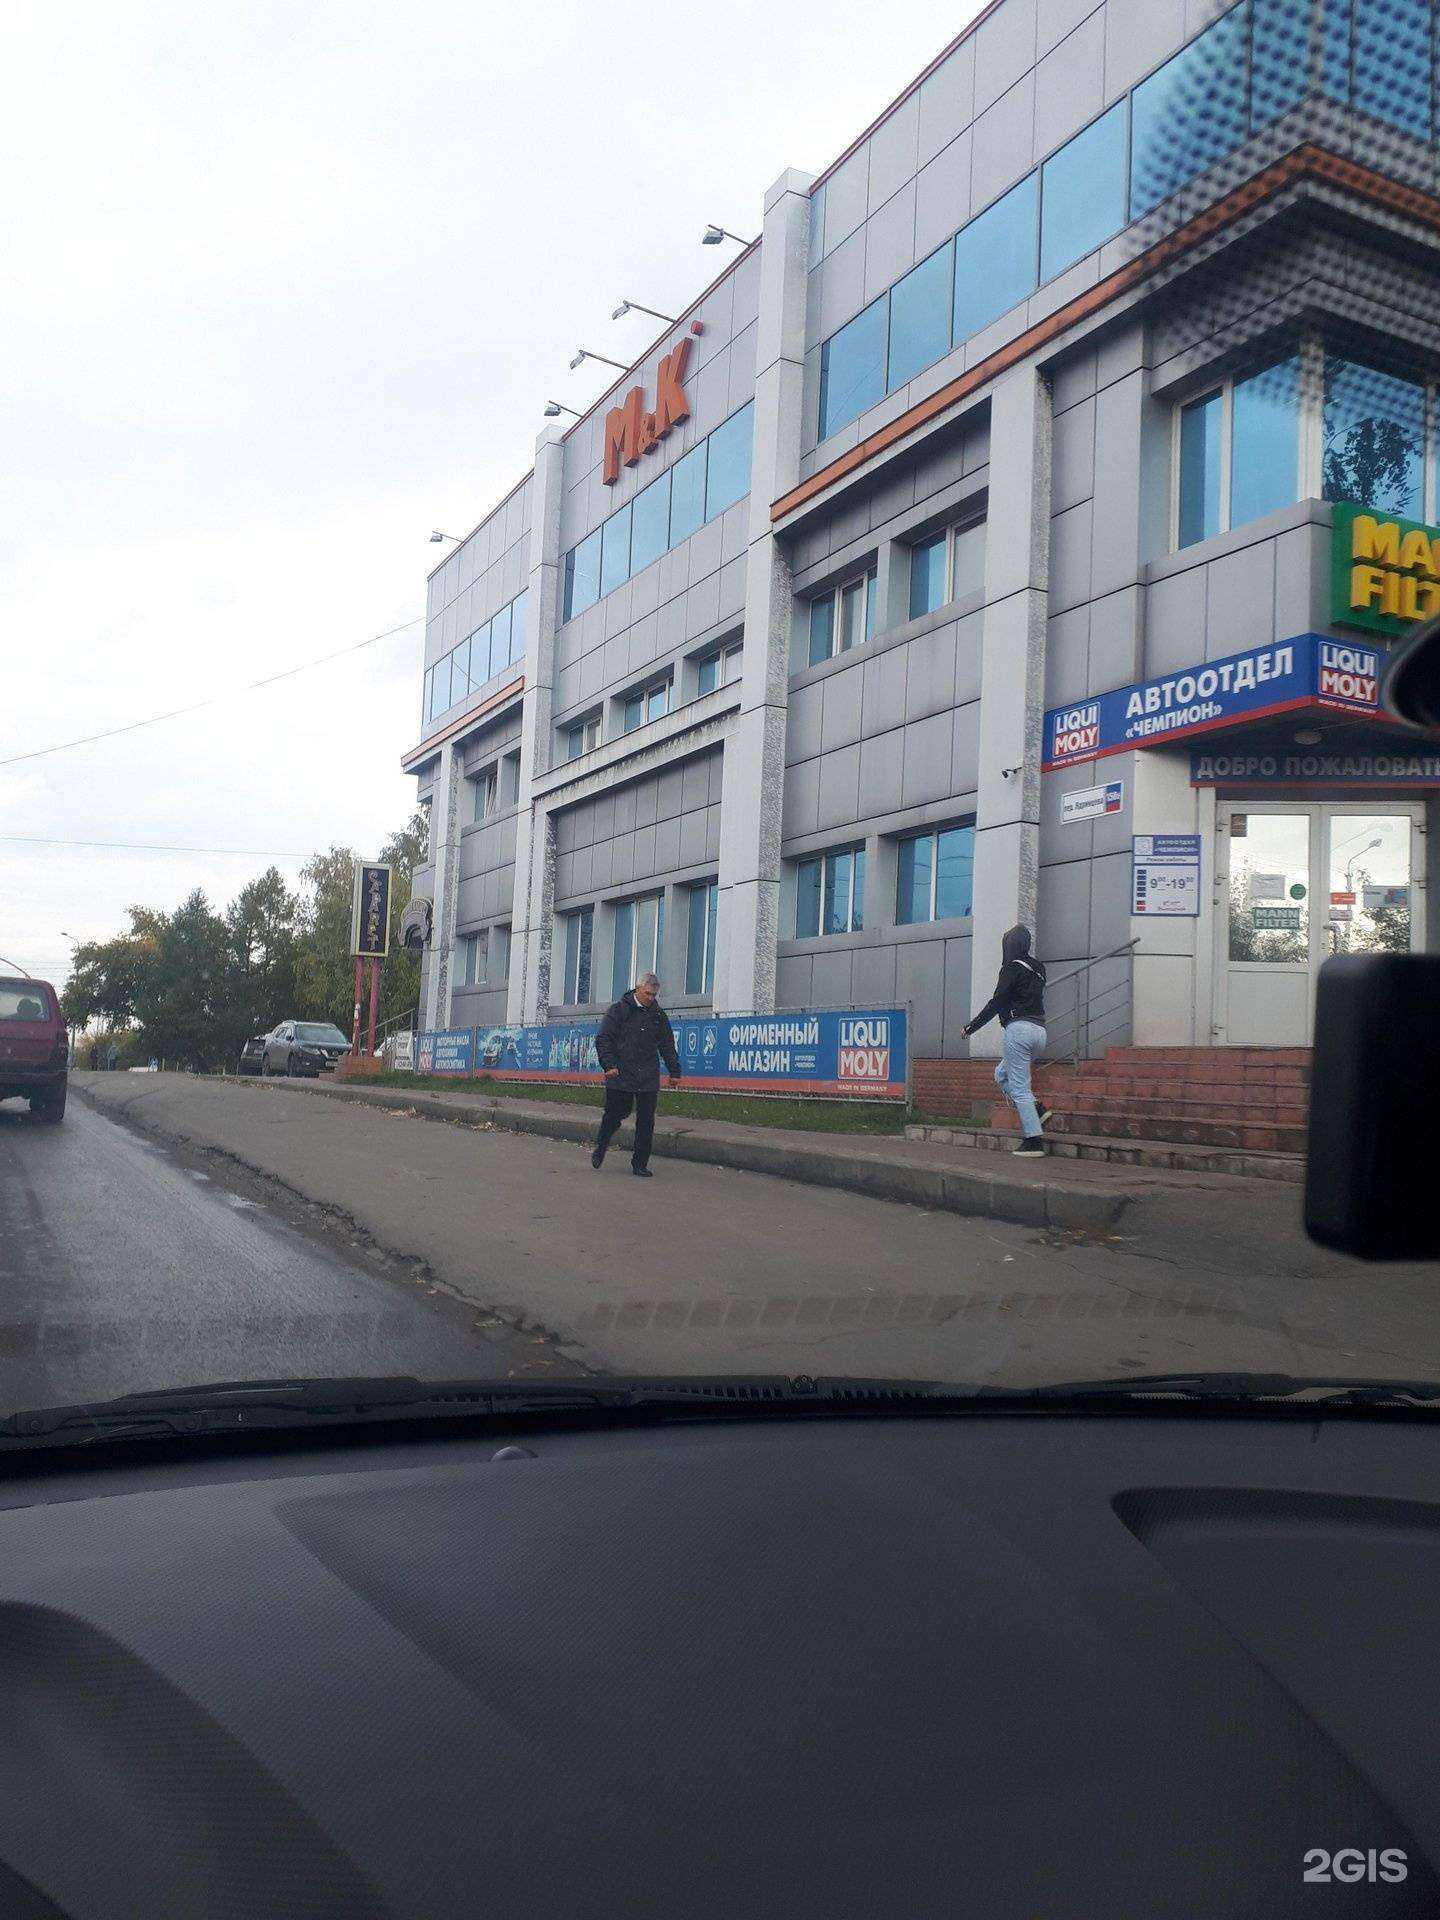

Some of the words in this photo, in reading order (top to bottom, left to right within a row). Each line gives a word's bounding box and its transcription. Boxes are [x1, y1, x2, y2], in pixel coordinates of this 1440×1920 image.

[1321, 644, 1375, 676] LIQUI
[1125, 646, 1293, 719] АВТООТДЕЛ
[1321, 669, 1377, 701] MOLY
[1055, 706, 1098, 735] LIQUI
[1125, 701, 1223, 739] «ЧЕМПИОН»
[1054, 726, 1098, 756] MOLY
[1197, 756, 1277, 779] ДОБРО
[1256, 919, 1299, 928] FILTER
[729, 1017, 819, 1046] ФИРМЕННЫЙ
[841, 1021, 888, 1048] LIQUI
[728, 1050, 791, 1072] МАГАЗИН
[840, 1050, 888, 1077] MOLY
